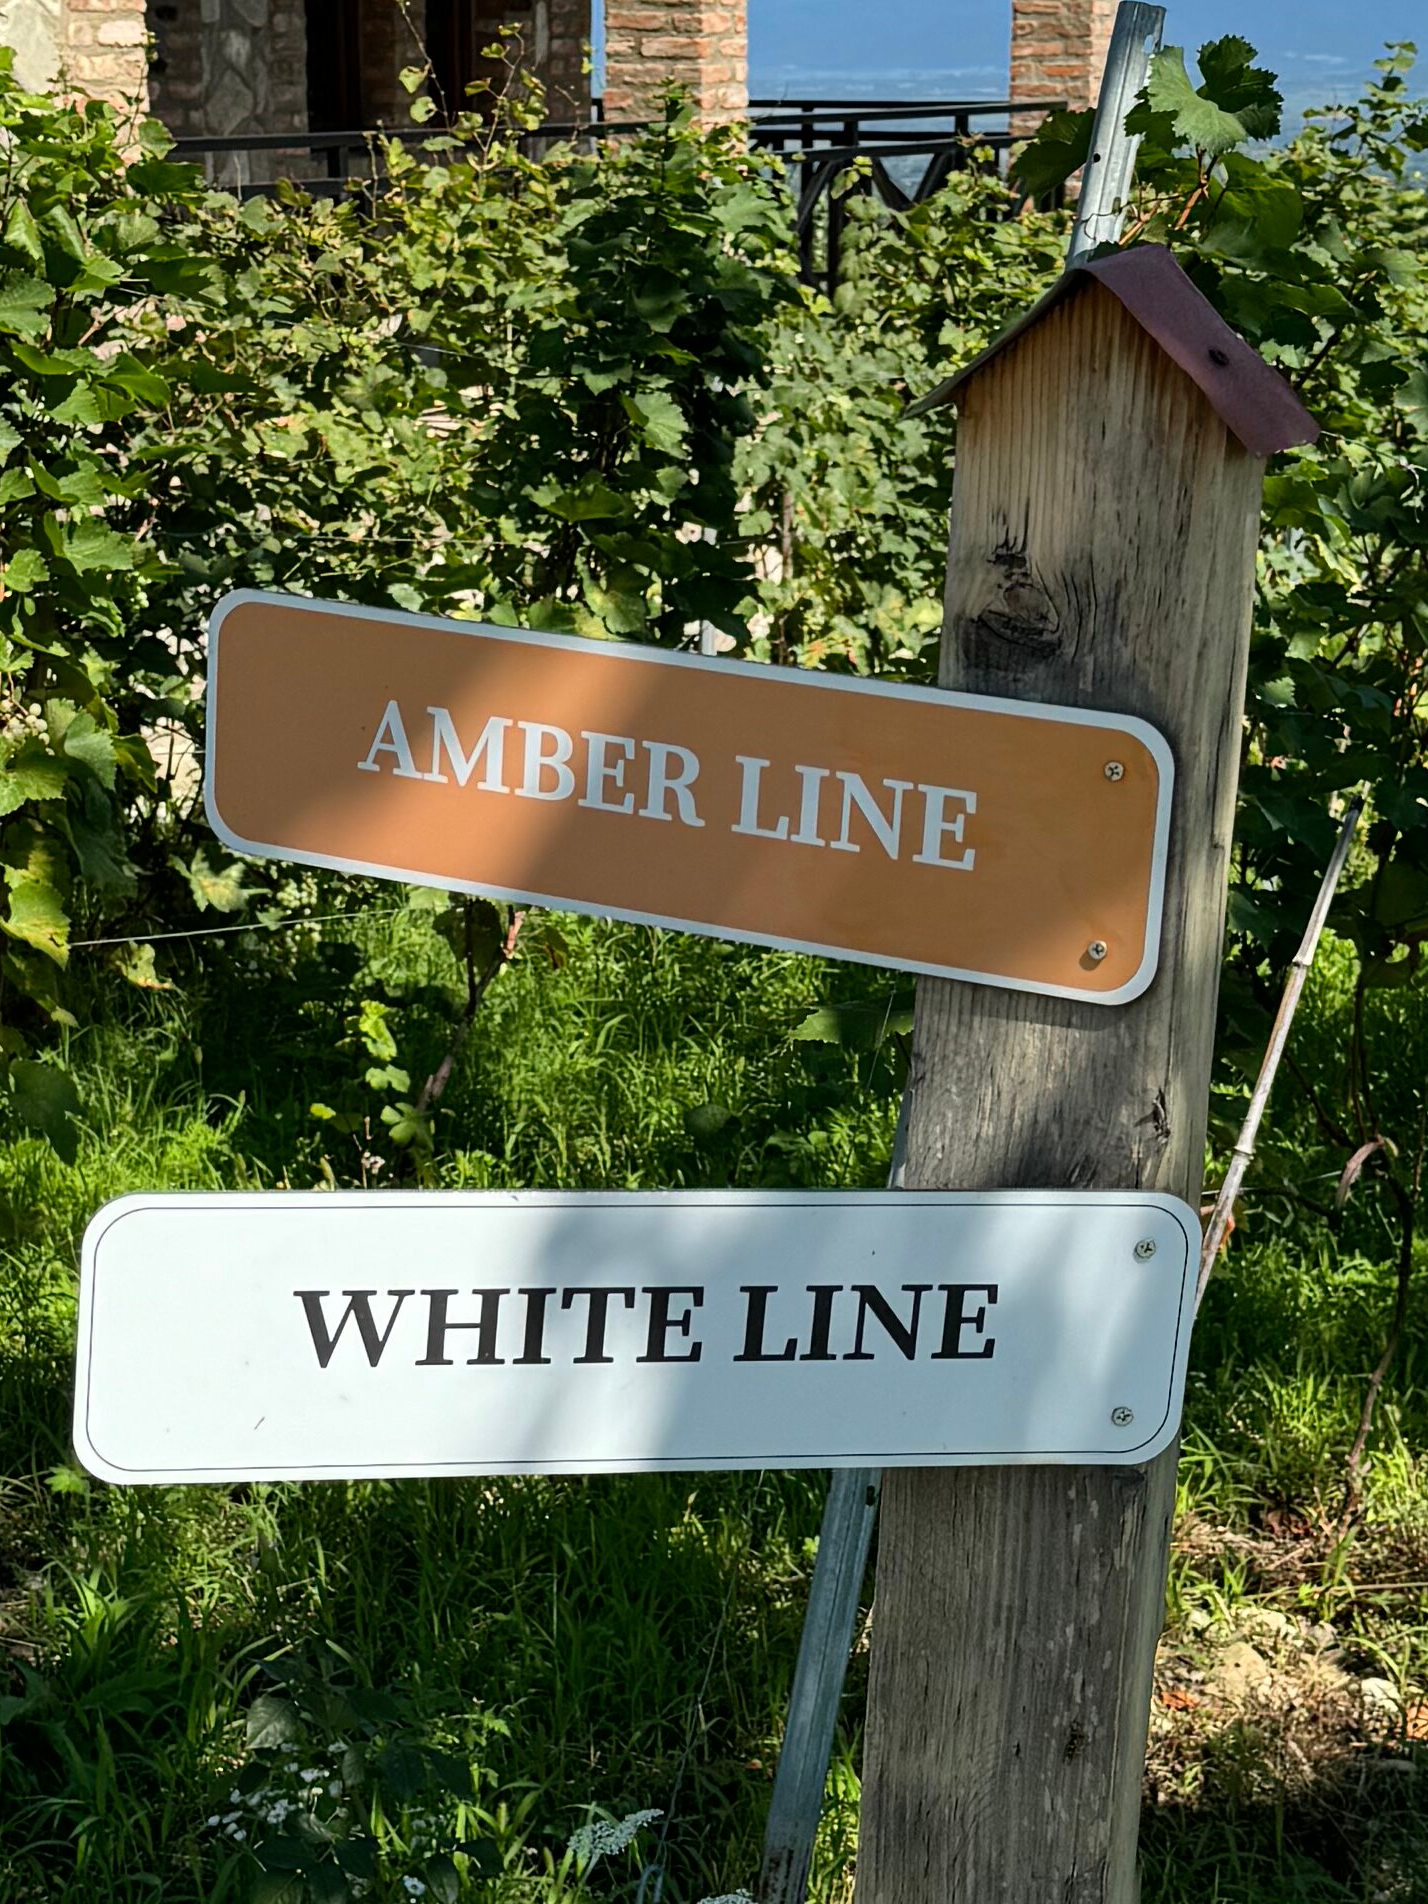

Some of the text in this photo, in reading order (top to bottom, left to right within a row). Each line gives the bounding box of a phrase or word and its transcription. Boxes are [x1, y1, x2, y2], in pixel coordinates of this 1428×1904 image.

[357, 699, 977, 872] AMBER LINE
[293, 1283, 999, 1369] WHITE LINE
